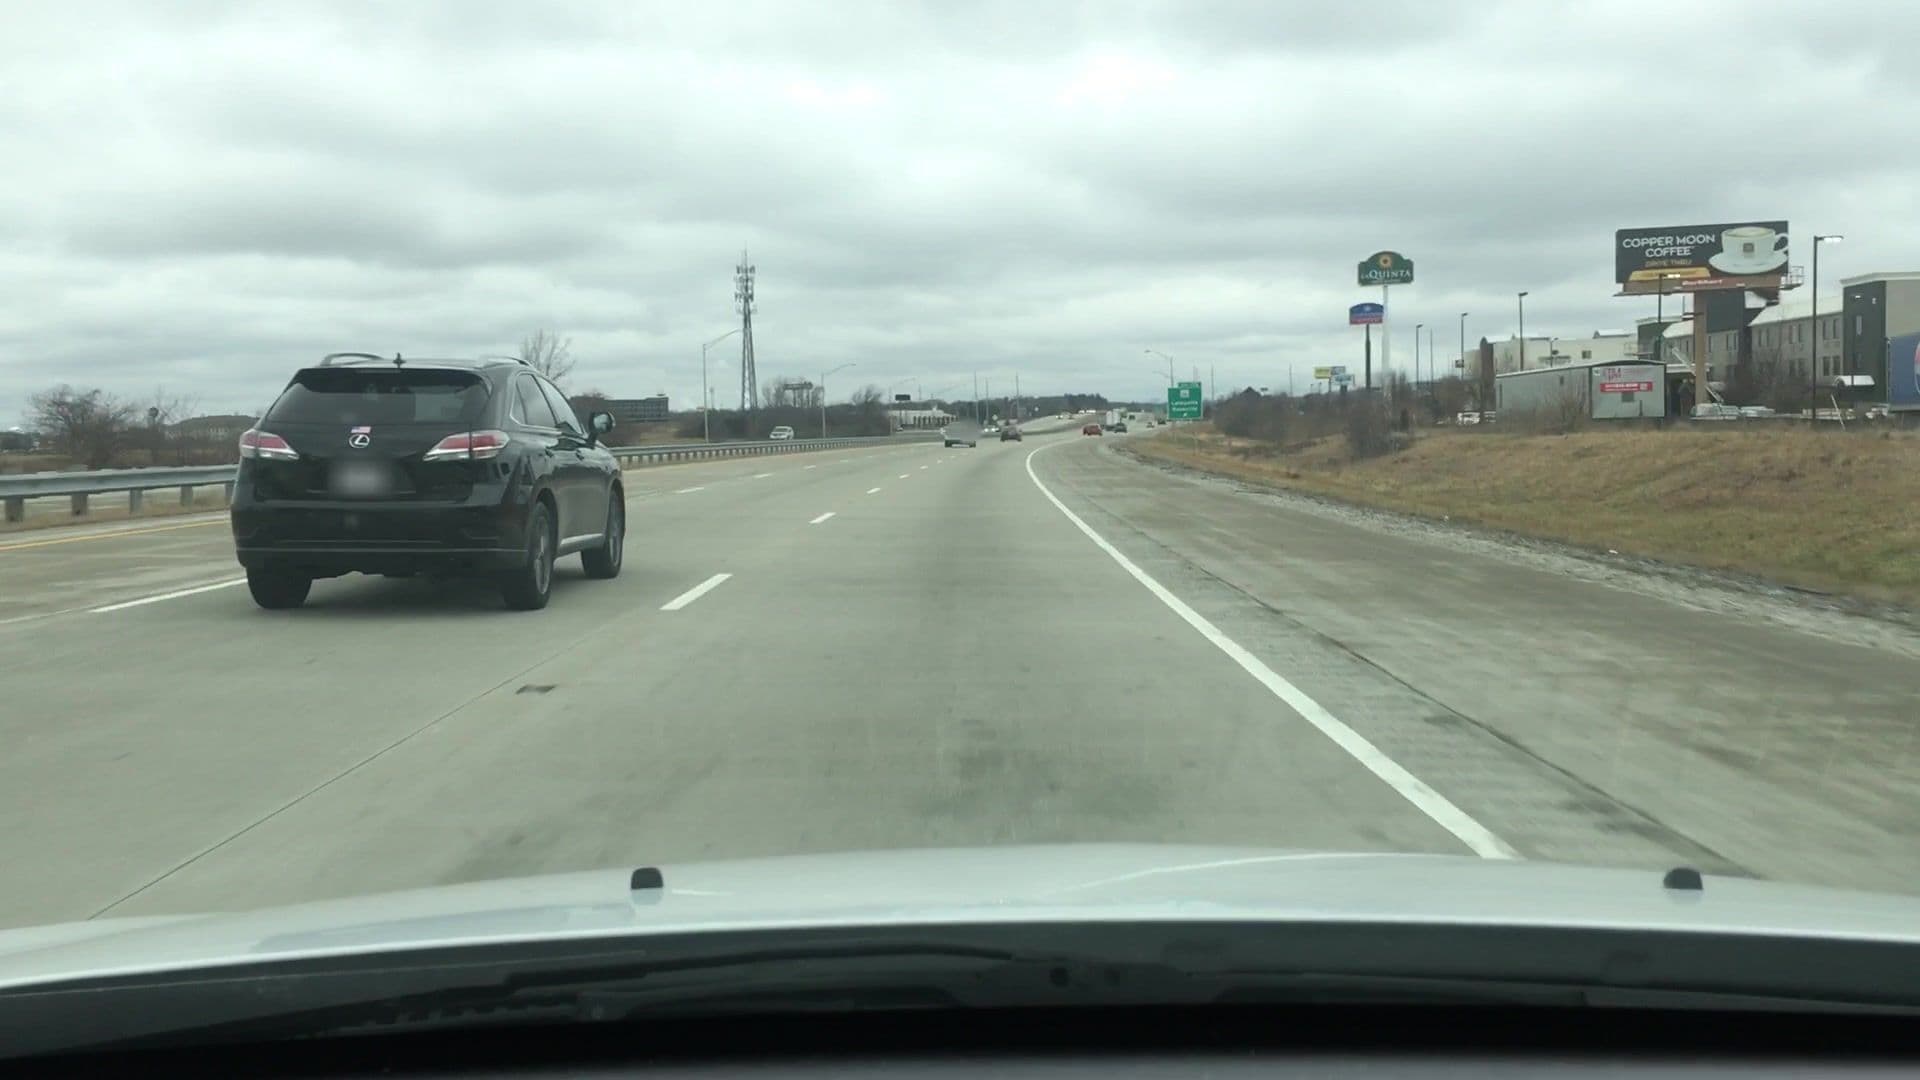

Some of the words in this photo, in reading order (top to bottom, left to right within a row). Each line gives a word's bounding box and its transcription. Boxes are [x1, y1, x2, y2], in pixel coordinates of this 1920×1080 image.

[1623, 236, 1674, 248] COPPER
[1676, 234, 1716, 245] MOON
[1645, 246, 1692, 257] COFFEE
[1369, 269, 1411, 280] QUINTA
